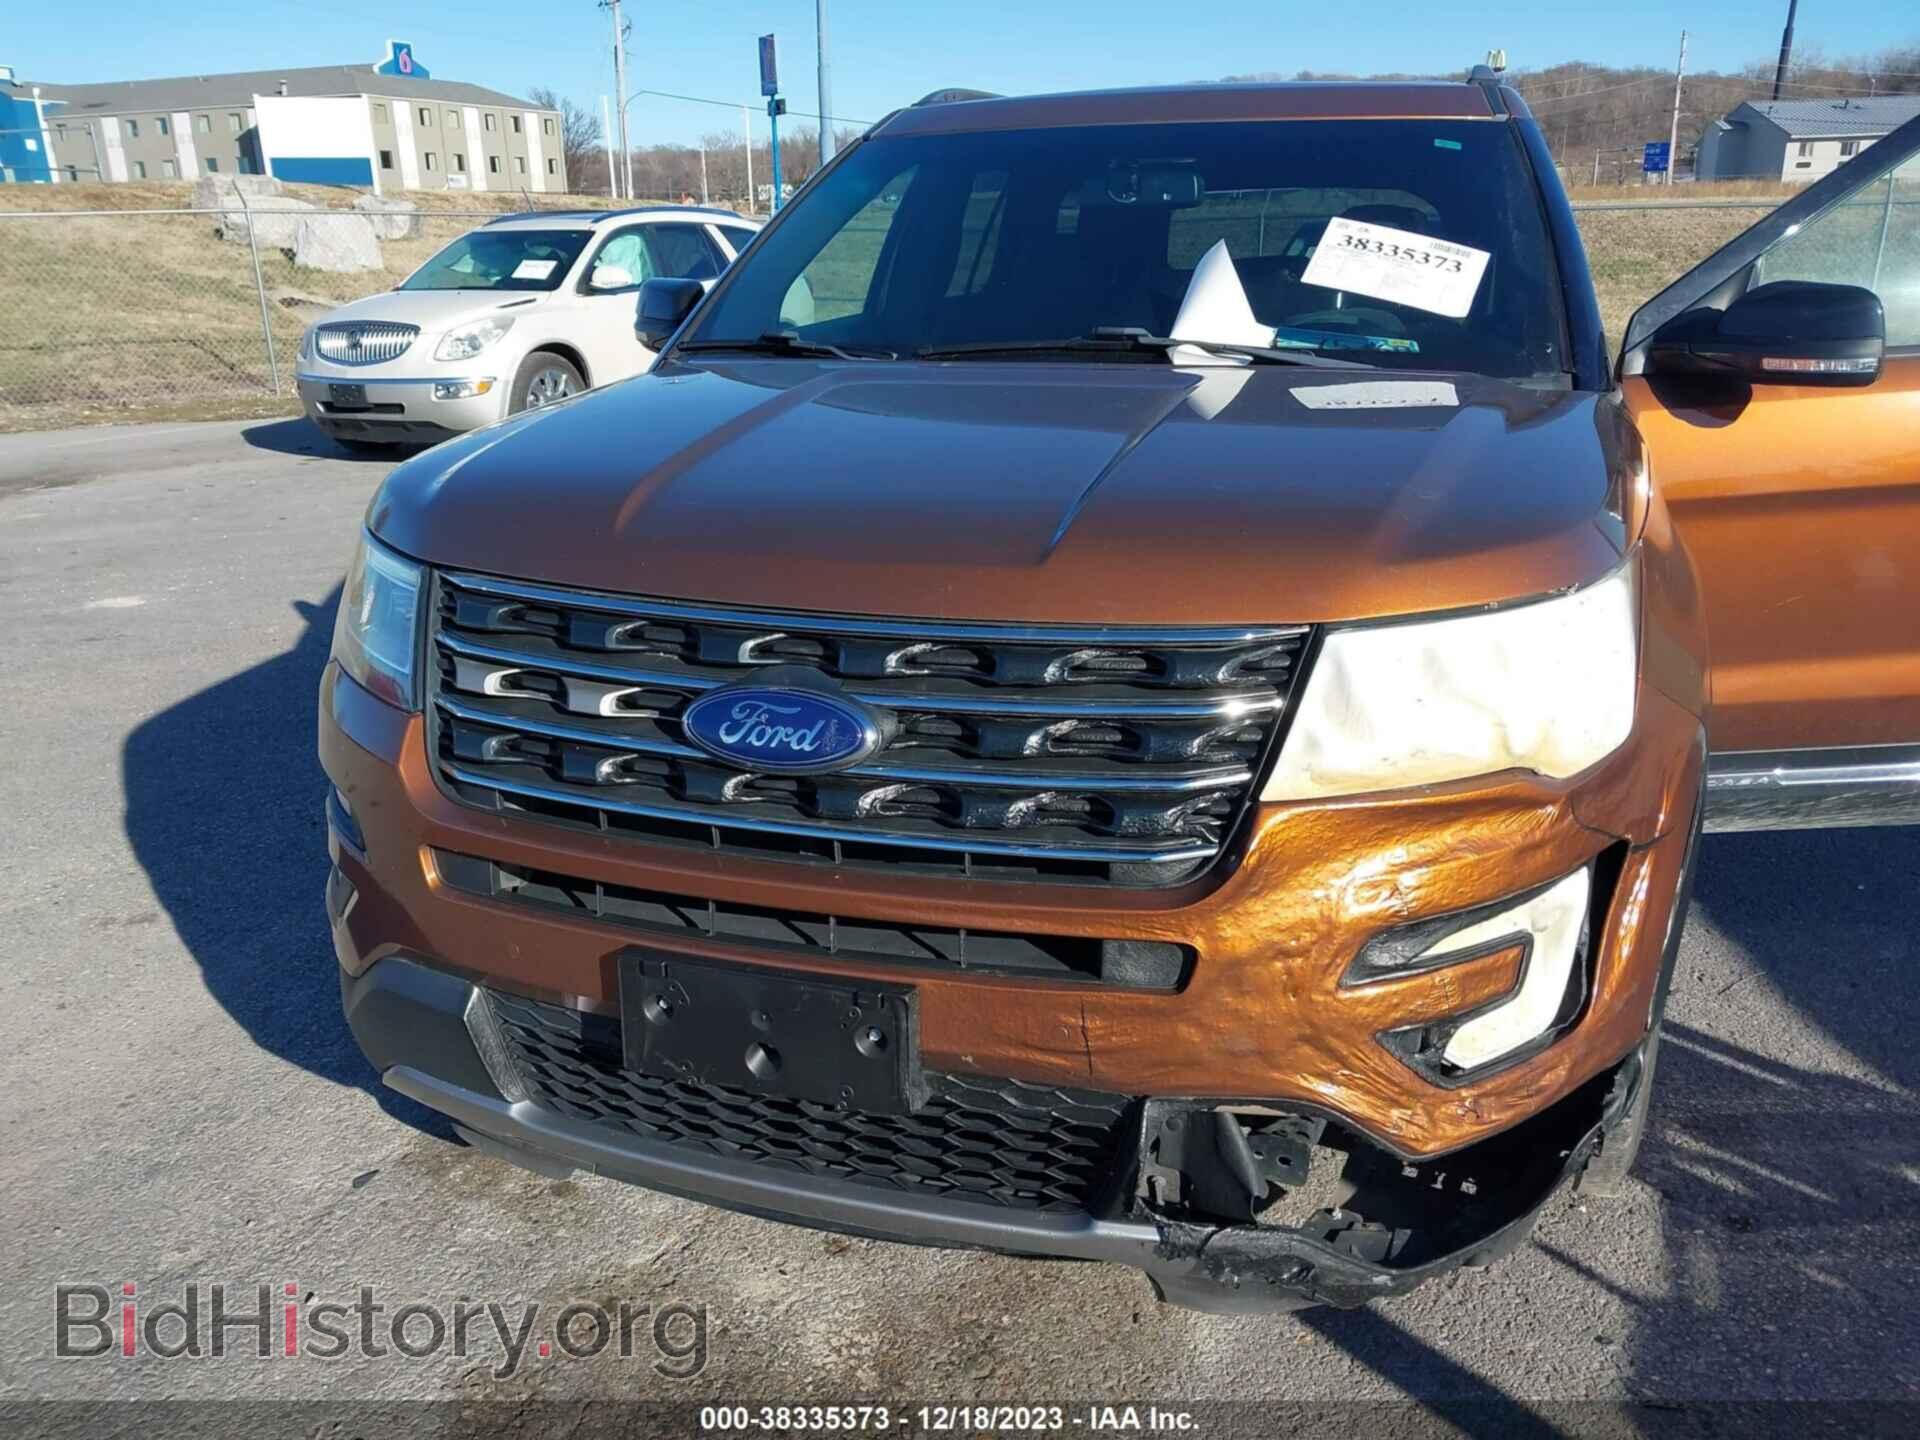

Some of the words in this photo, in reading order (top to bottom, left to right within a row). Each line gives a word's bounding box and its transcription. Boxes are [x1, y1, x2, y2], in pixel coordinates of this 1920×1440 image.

[399, 47, 412, 74] 6
[1337, 234, 1463, 273] 38335373
[718, 700, 827, 752] Ford
